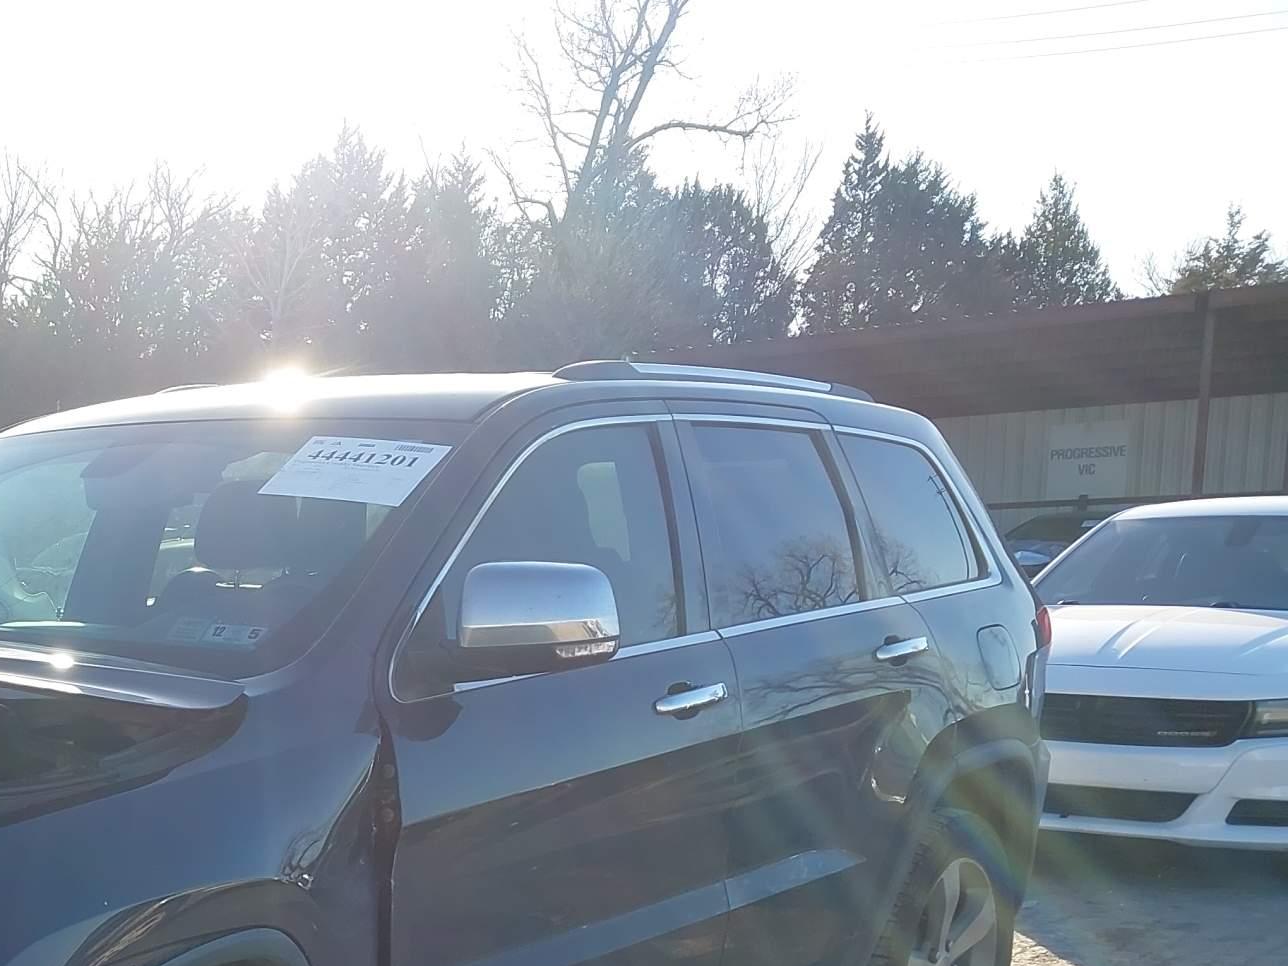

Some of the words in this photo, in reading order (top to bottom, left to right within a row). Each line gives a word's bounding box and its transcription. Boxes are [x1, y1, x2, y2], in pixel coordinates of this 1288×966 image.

[307, 449, 420, 468] 44441201
[1050, 445, 1127, 461] PROGRESSIVE
[1078, 463, 1096, 476] VIC
